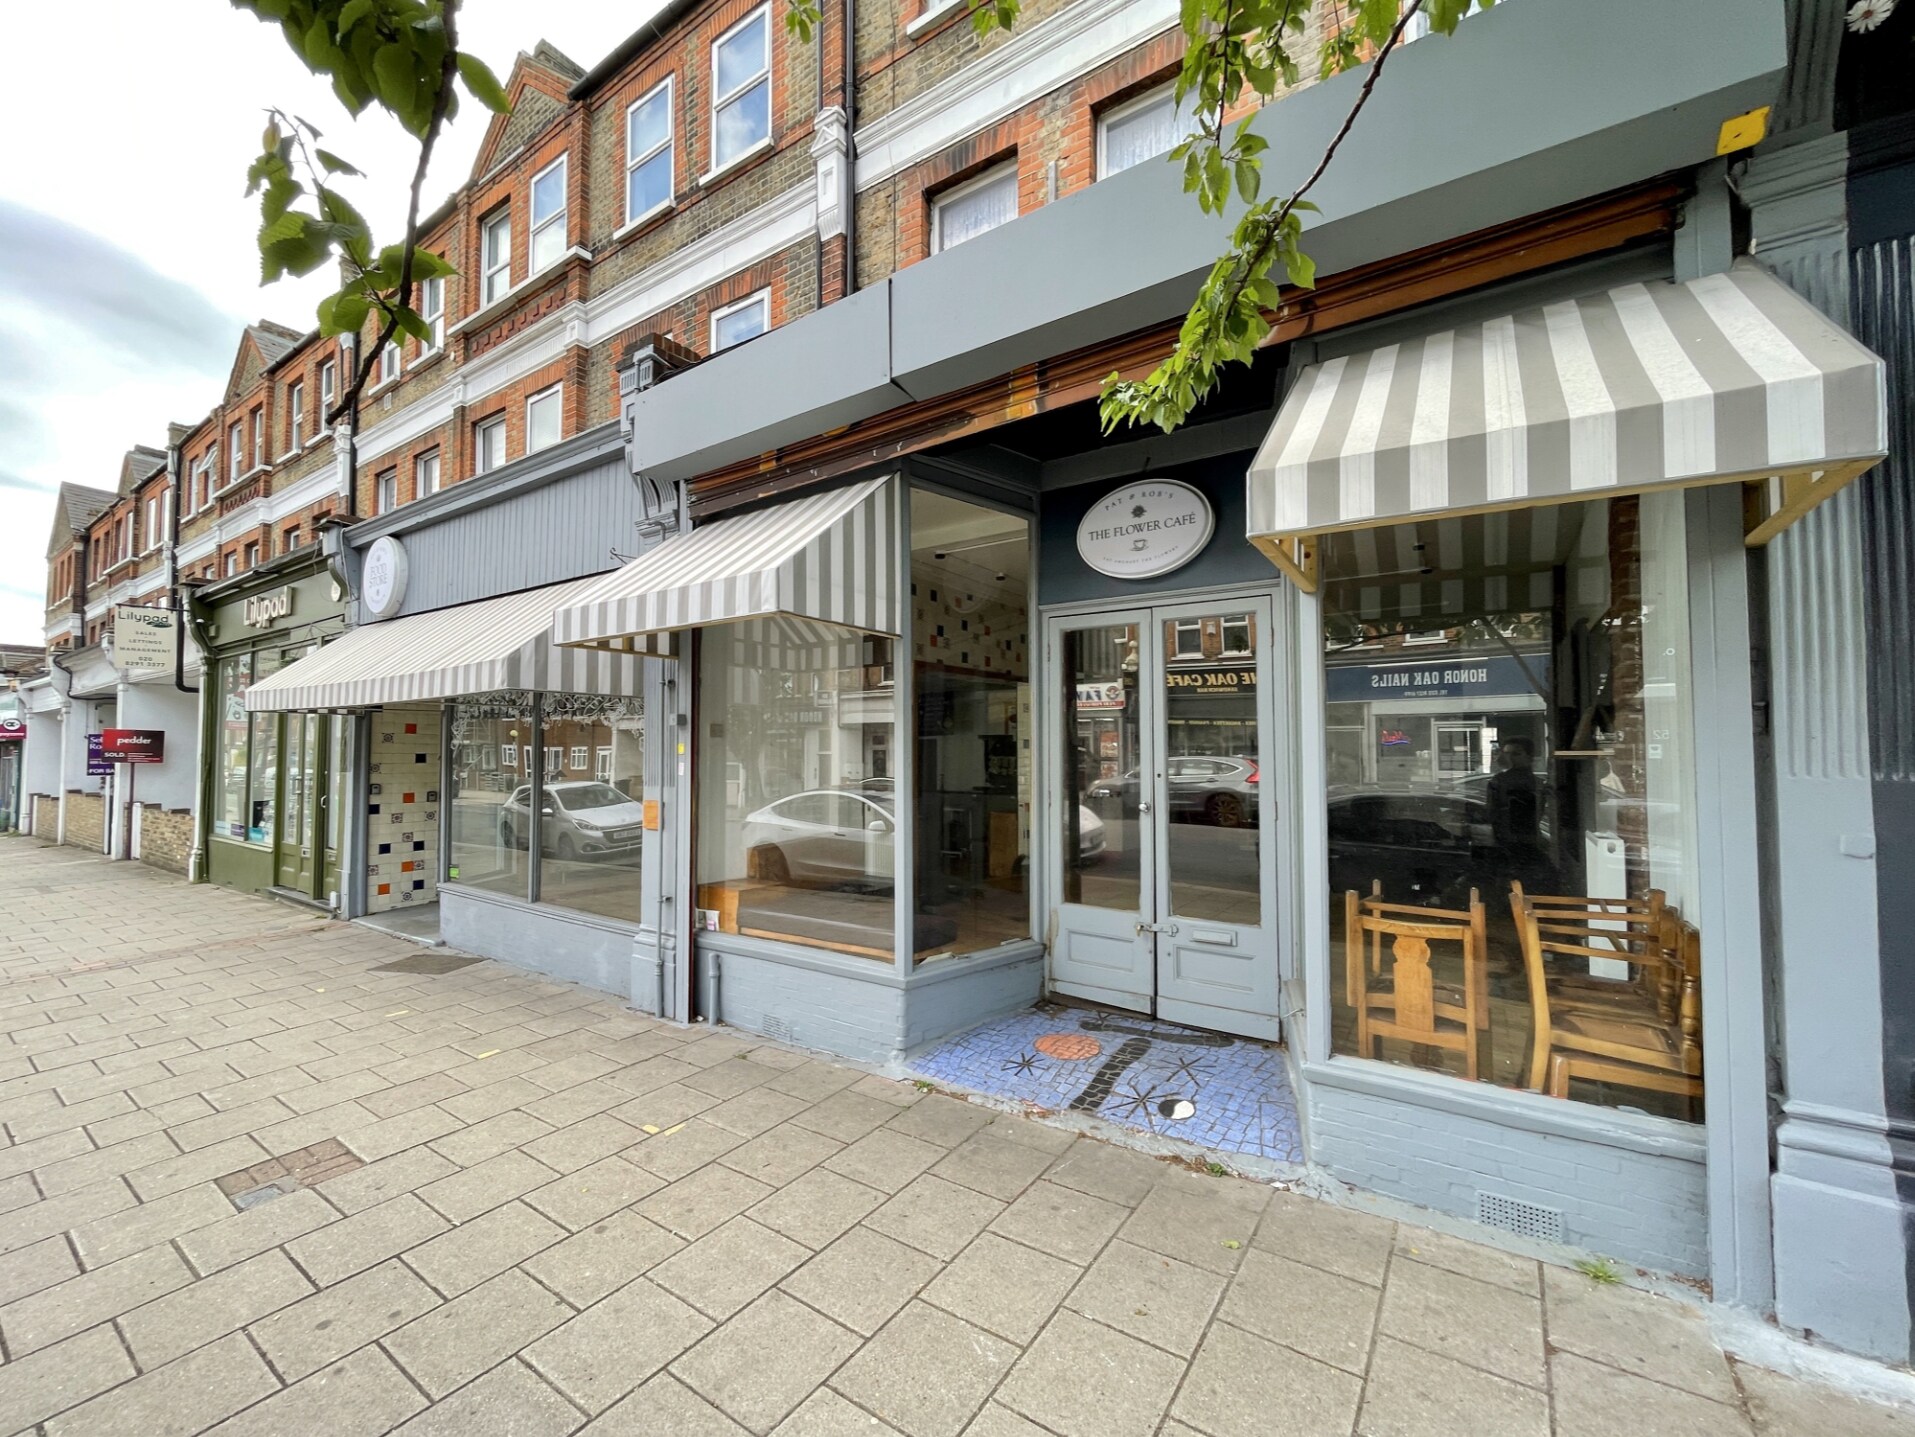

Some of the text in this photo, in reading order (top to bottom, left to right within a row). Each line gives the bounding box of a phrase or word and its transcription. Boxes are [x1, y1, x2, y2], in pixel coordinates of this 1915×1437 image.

[1104, 498, 1123, 511] PAT
[1142, 490, 1174, 499] ROB'S
[1088, 511, 1196, 541] THE FLOWER CAFÉ
[118, 610, 169, 623] Lilypad
[243, 585, 293, 629] Lilypad
[117, 736, 152, 746] pedder
